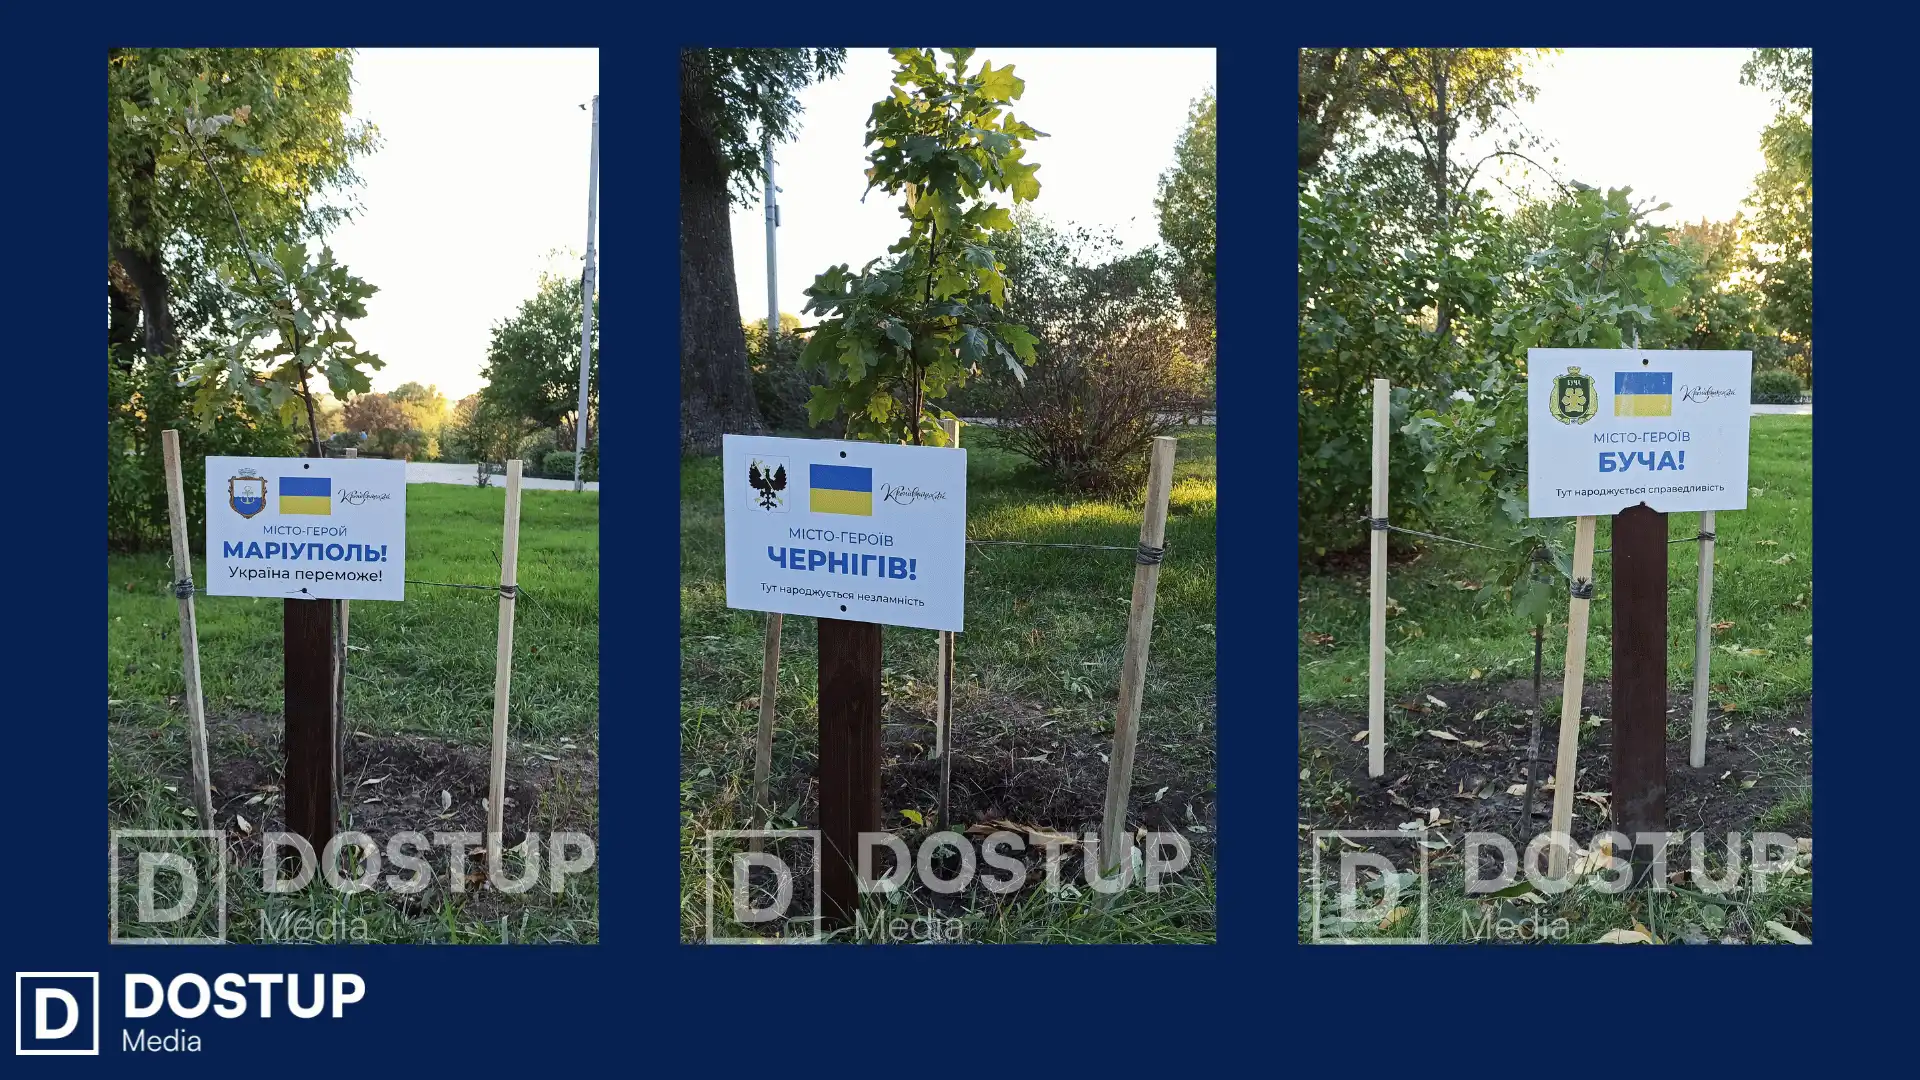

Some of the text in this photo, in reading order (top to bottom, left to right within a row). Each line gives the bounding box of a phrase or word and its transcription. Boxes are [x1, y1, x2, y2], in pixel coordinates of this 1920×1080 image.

[1593, 430, 1691, 444] МІСТО-ГЕРОЇВ
[1598, 450, 1685, 473] БУЧА!
[1555, 484, 1725, 498] Тут народжується справедливість
[263, 525, 347, 537] МІСТО-ГЕРОЙ
[789, 527, 894, 547] МІСТО-ГЕРОЇВ
[223, 541, 388, 563] МАРІУПОЛЬ!
[767, 545, 917, 581] ЧЕРНІГІВ!
[228, 566, 383, 583] Україна переможе!
[760, 582, 925, 607] Тут народжується незламність
